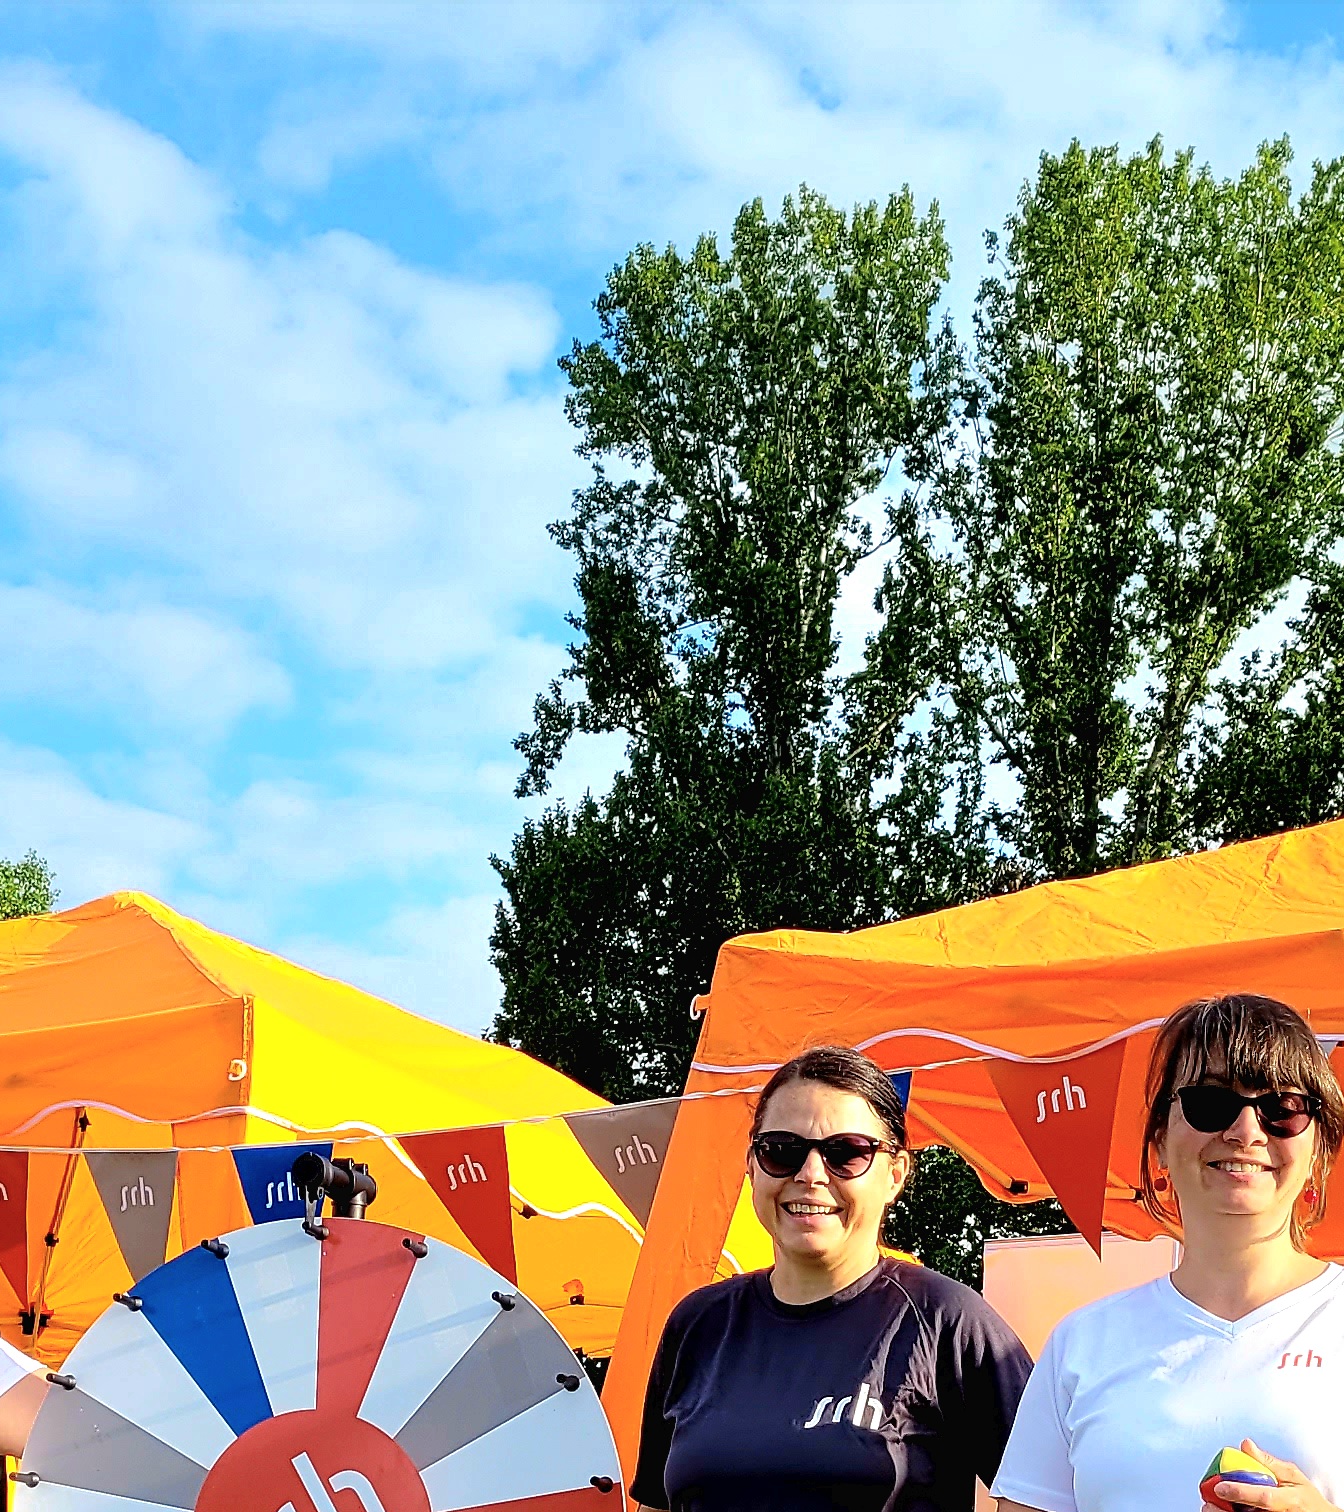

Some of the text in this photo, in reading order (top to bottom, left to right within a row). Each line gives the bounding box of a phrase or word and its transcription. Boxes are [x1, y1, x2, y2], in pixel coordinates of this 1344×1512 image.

[1036, 1076, 1087, 1123] srh
[447, 1154, 488, 1191] srh
[614, 1135, 658, 1174] srh
[120, 1176, 154, 1212] srh
[1277, 1349, 1323, 1370] srh
[804, 1382, 883, 1431] srh
